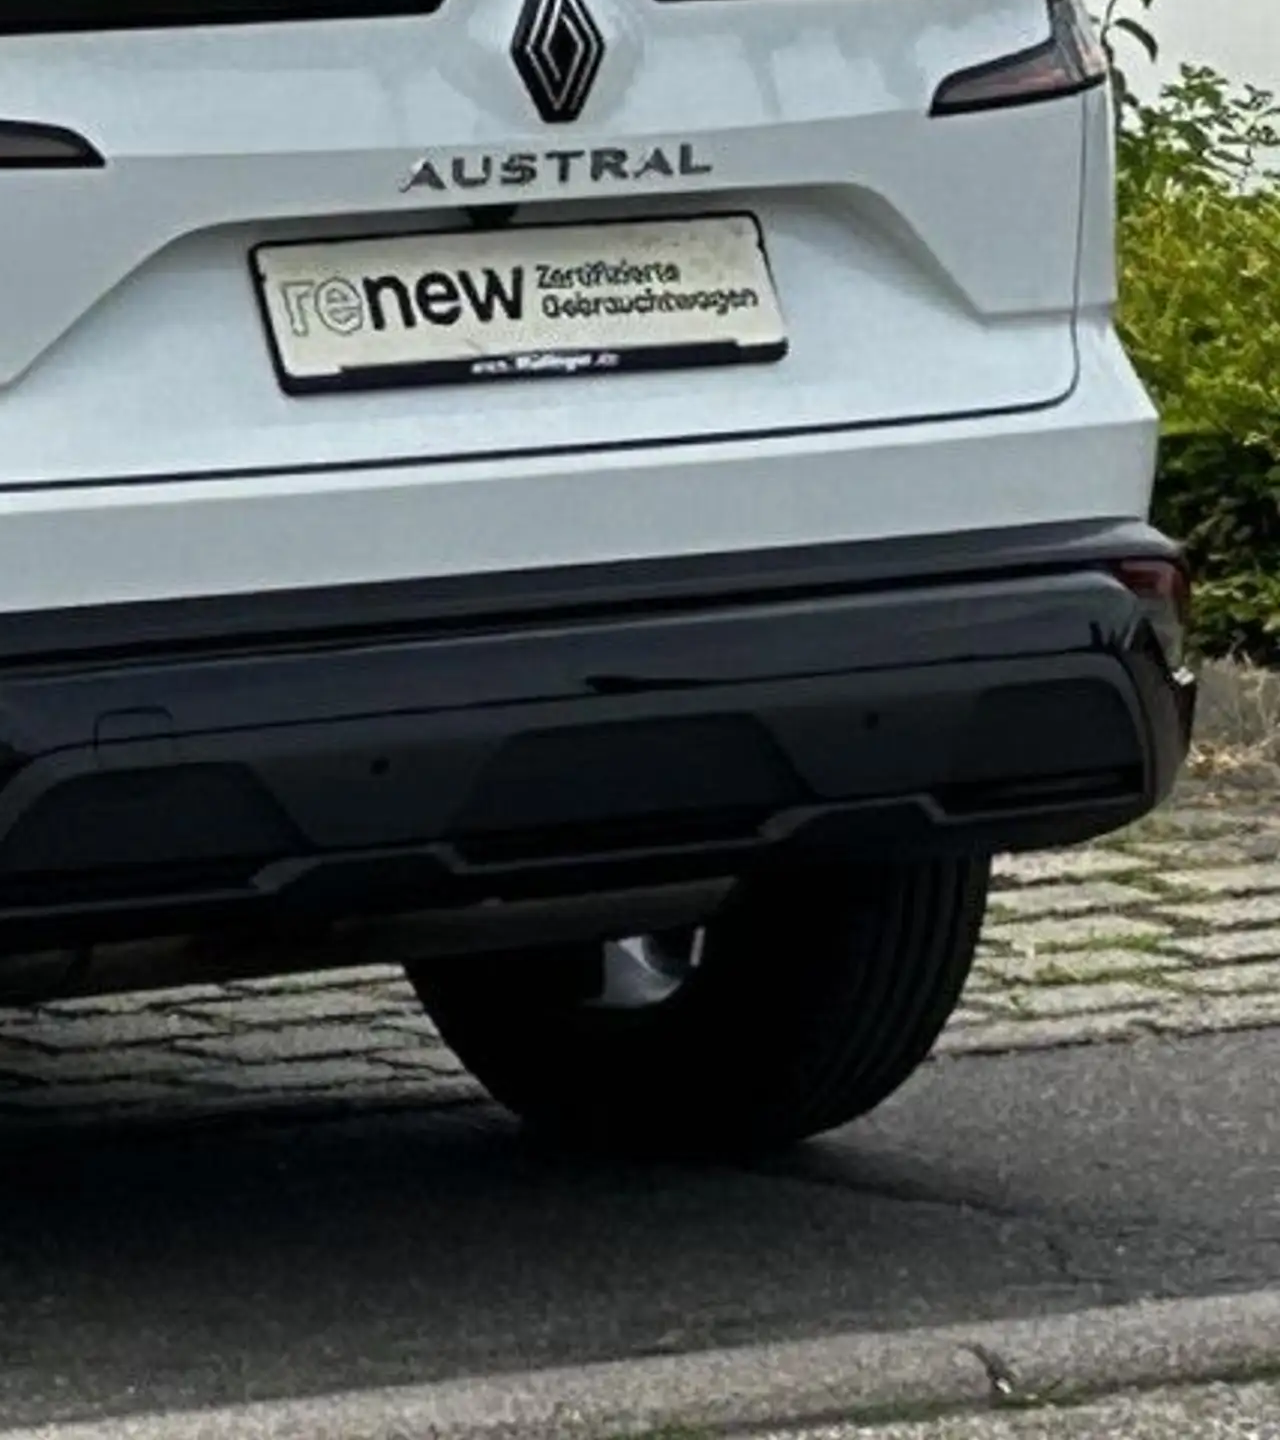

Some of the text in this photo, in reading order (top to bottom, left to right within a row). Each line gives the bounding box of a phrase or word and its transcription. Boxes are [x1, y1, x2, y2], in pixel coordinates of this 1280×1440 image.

[399, 143, 713, 193] AUSTRAL
[535, 260, 680, 289] Zertifizierte
[278, 265, 525, 337] renew
[540, 289, 760, 320] Gebrauchtwagen
